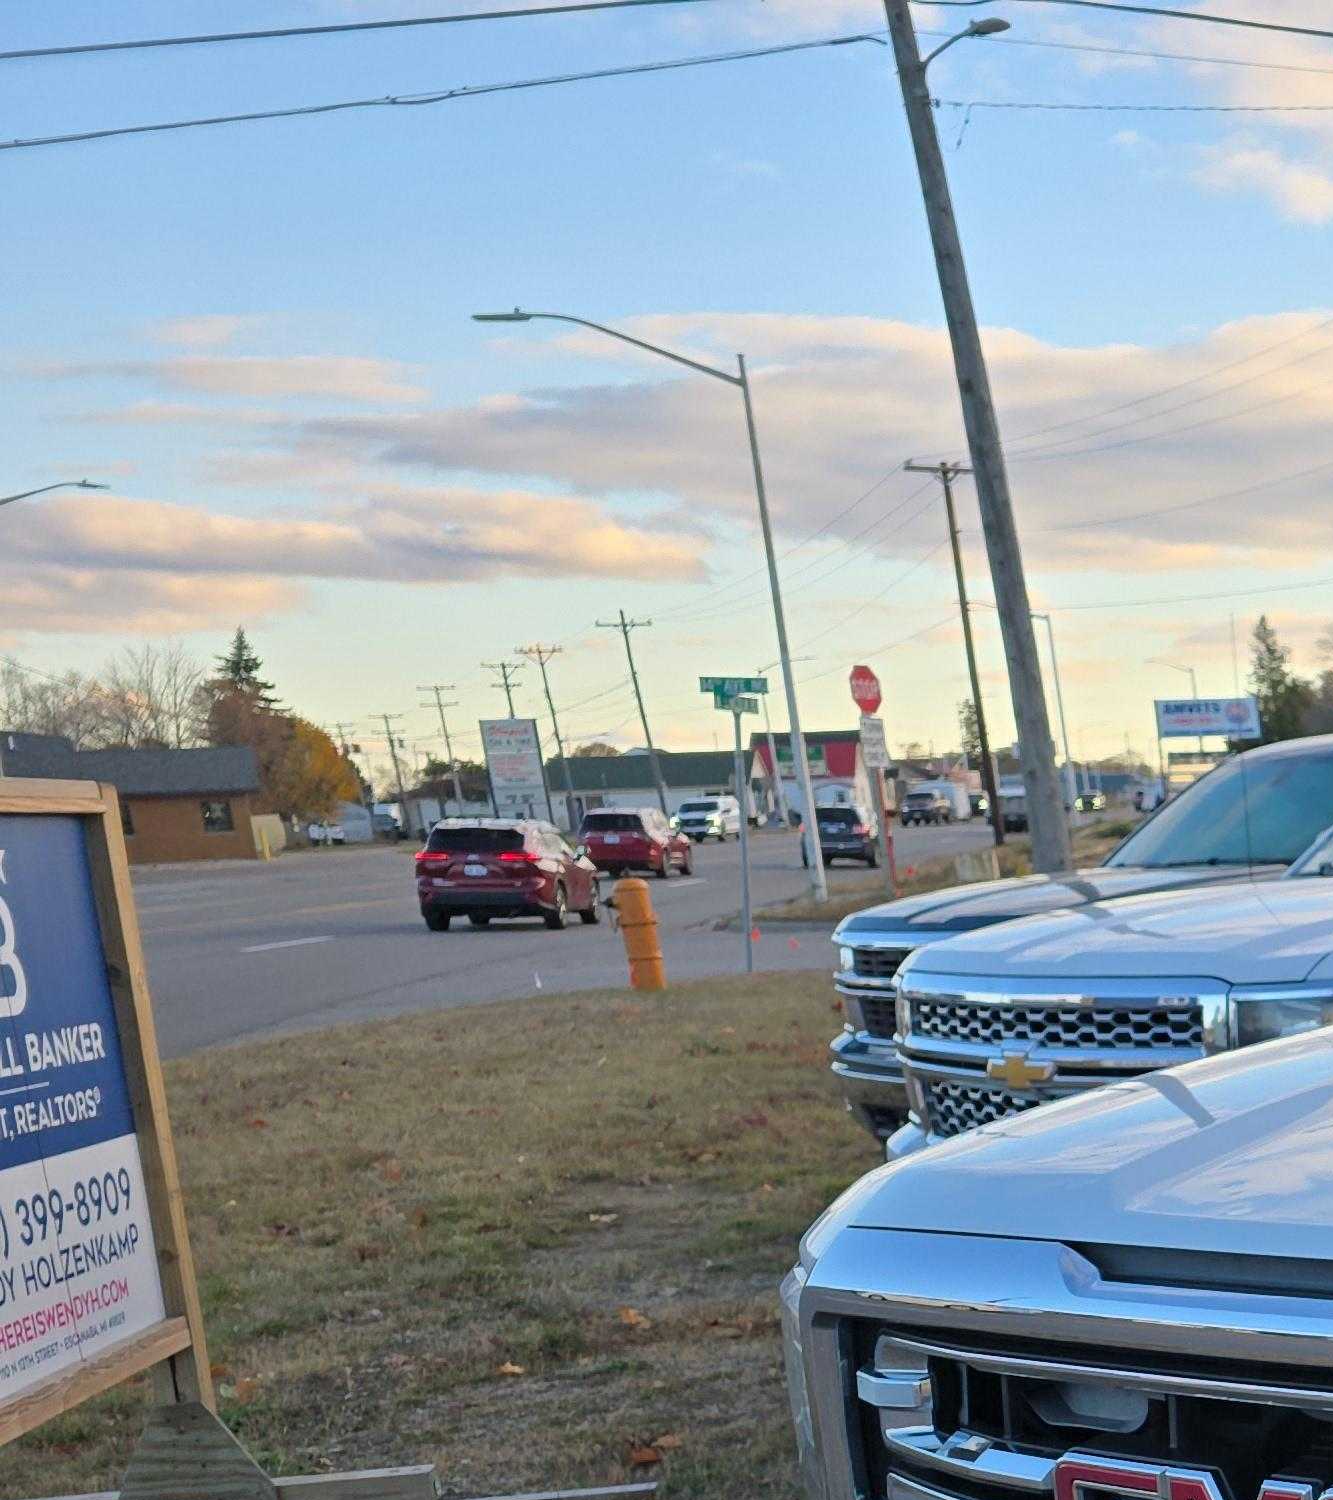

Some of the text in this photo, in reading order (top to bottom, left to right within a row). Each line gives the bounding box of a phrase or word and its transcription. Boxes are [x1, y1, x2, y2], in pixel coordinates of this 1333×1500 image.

[25, 1022, 106, 1072] BANKER
[15, 1167, 131, 1246] 399-8909
[21, 1222, 139, 1296] HOLZENKAMP
